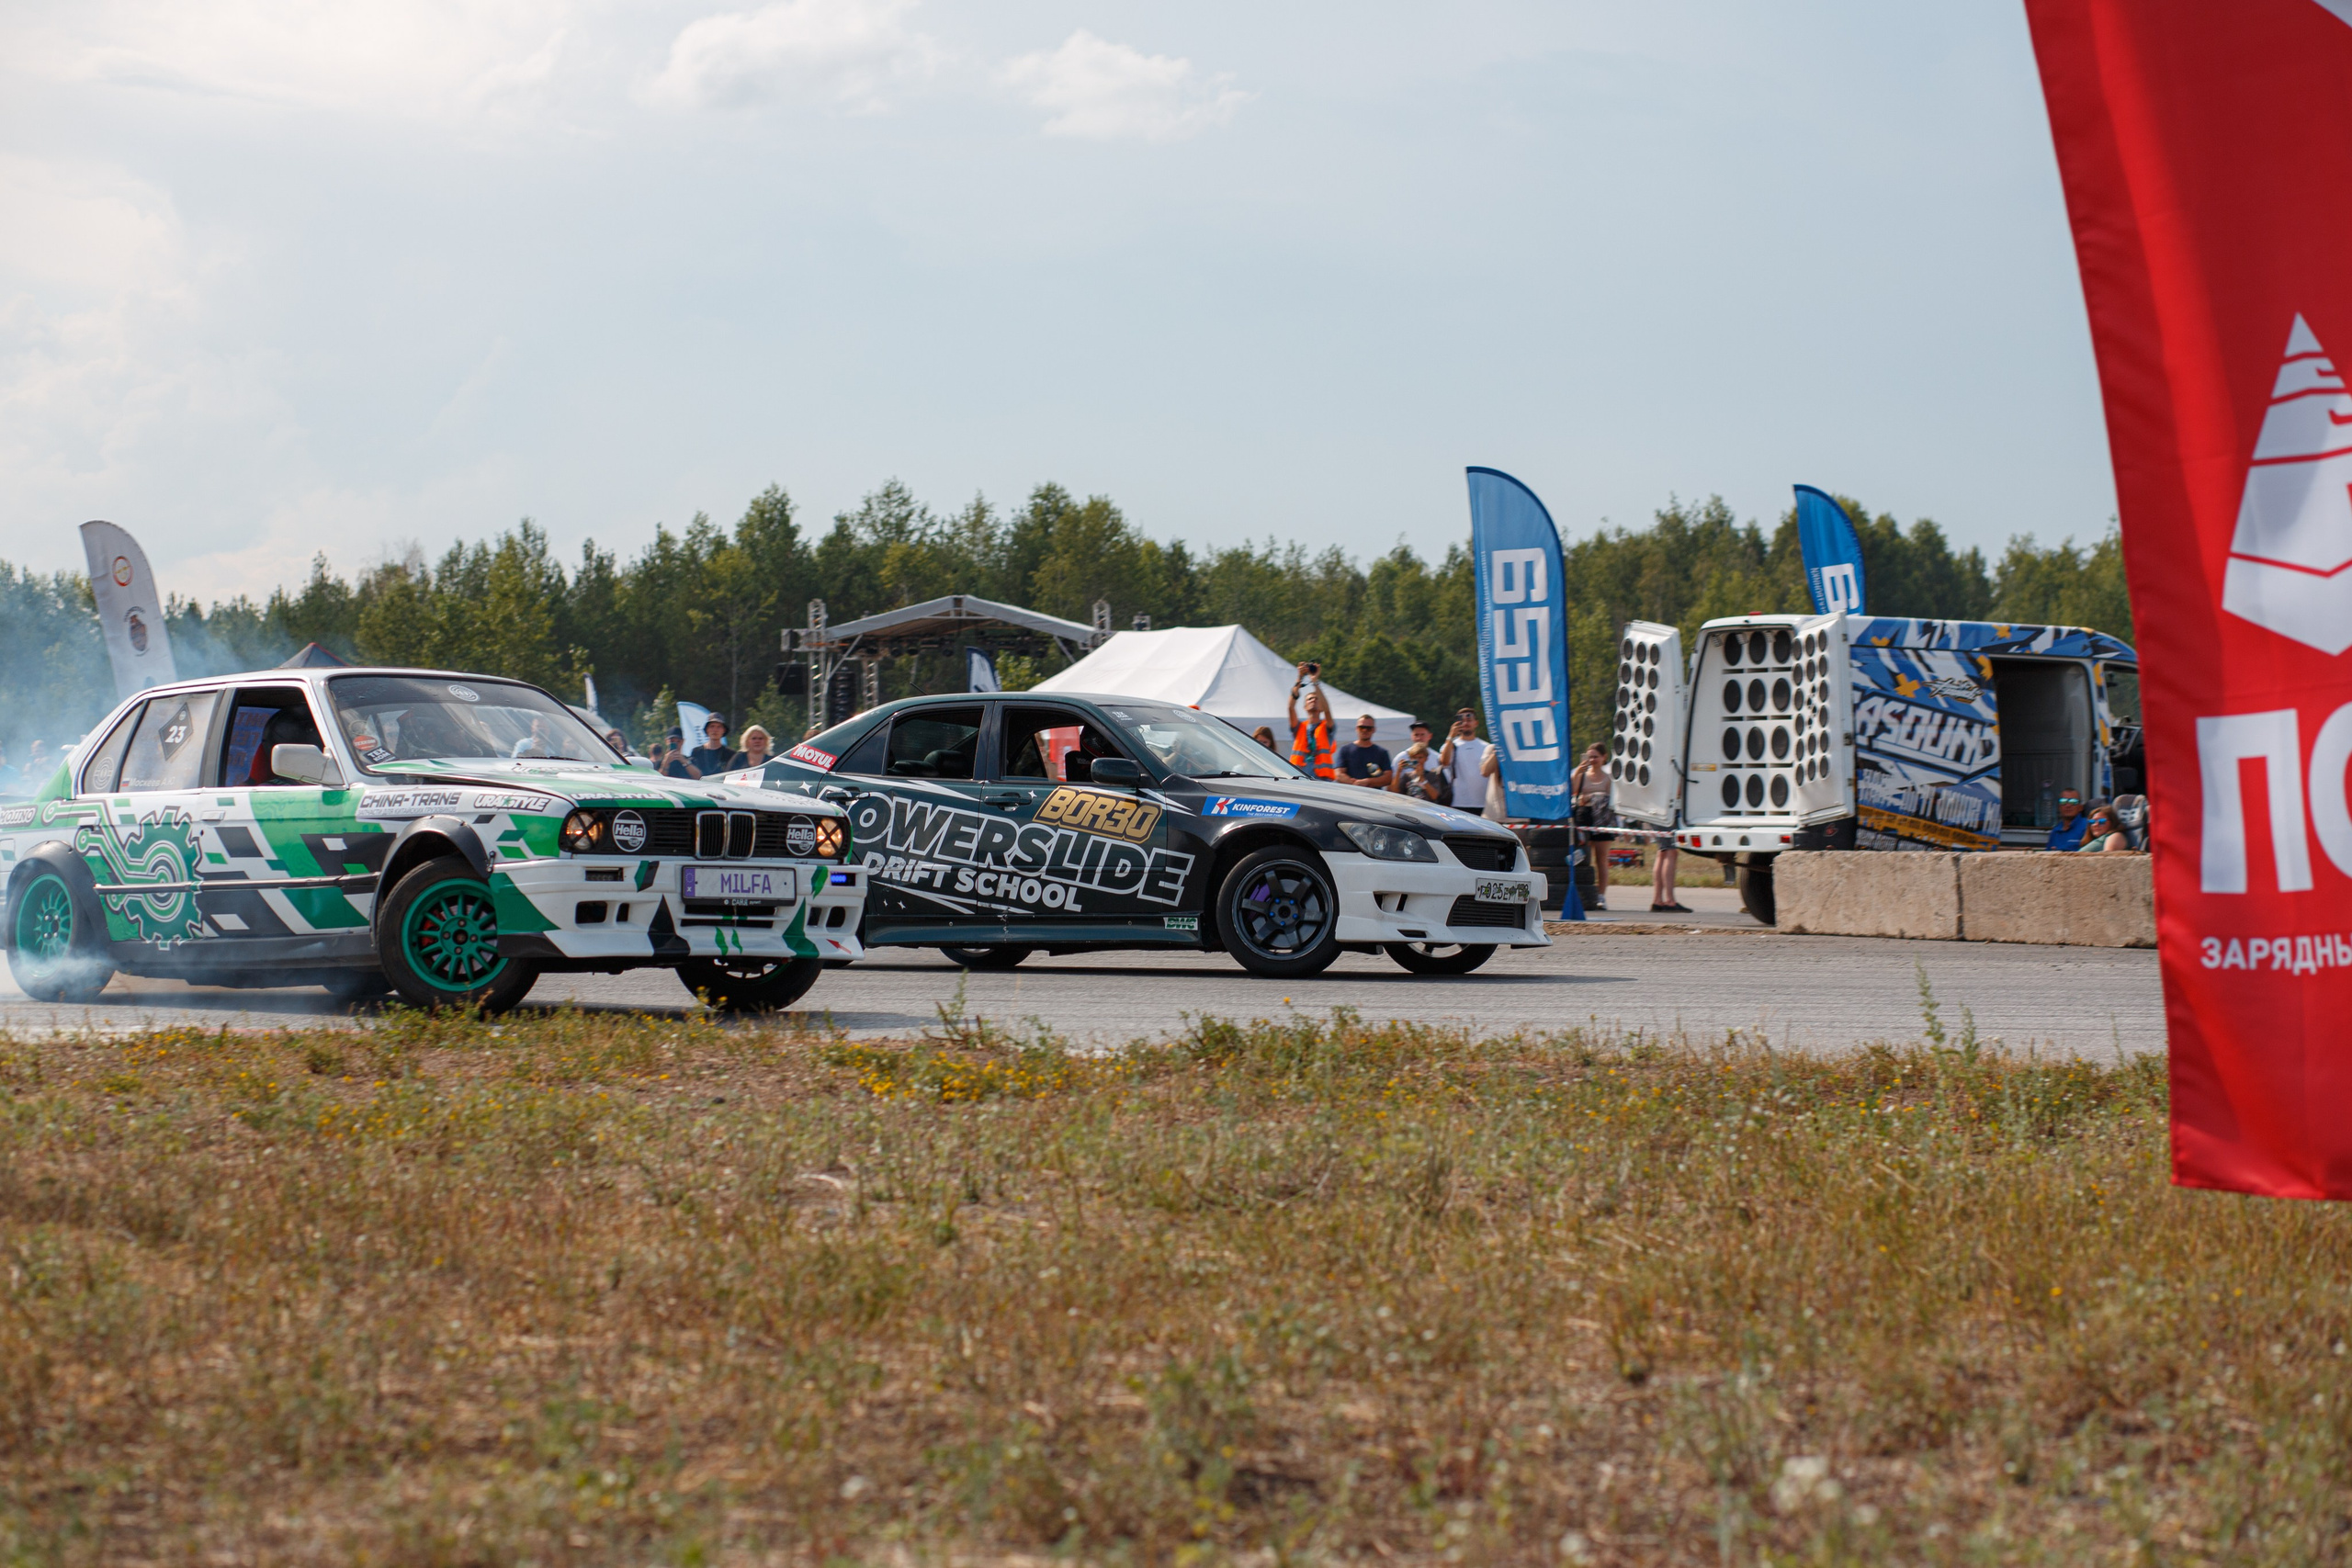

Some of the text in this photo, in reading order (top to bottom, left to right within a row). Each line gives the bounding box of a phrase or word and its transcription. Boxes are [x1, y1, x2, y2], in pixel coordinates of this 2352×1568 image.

[165, 726, 187, 743] 23
[793, 748, 833, 767] MOTUL
[360, 792, 463, 808] CHINA-TRANS
[1232, 804, 1291, 815] KINFOREST
[616, 824, 643, 836] Hella
[786, 829, 814, 840] Hella
[817, 785, 1195, 907] OWERSLIDE
[720, 874, 772, 894] MILFA
[863, 852, 1082, 912] DRIFT SCHOOL
